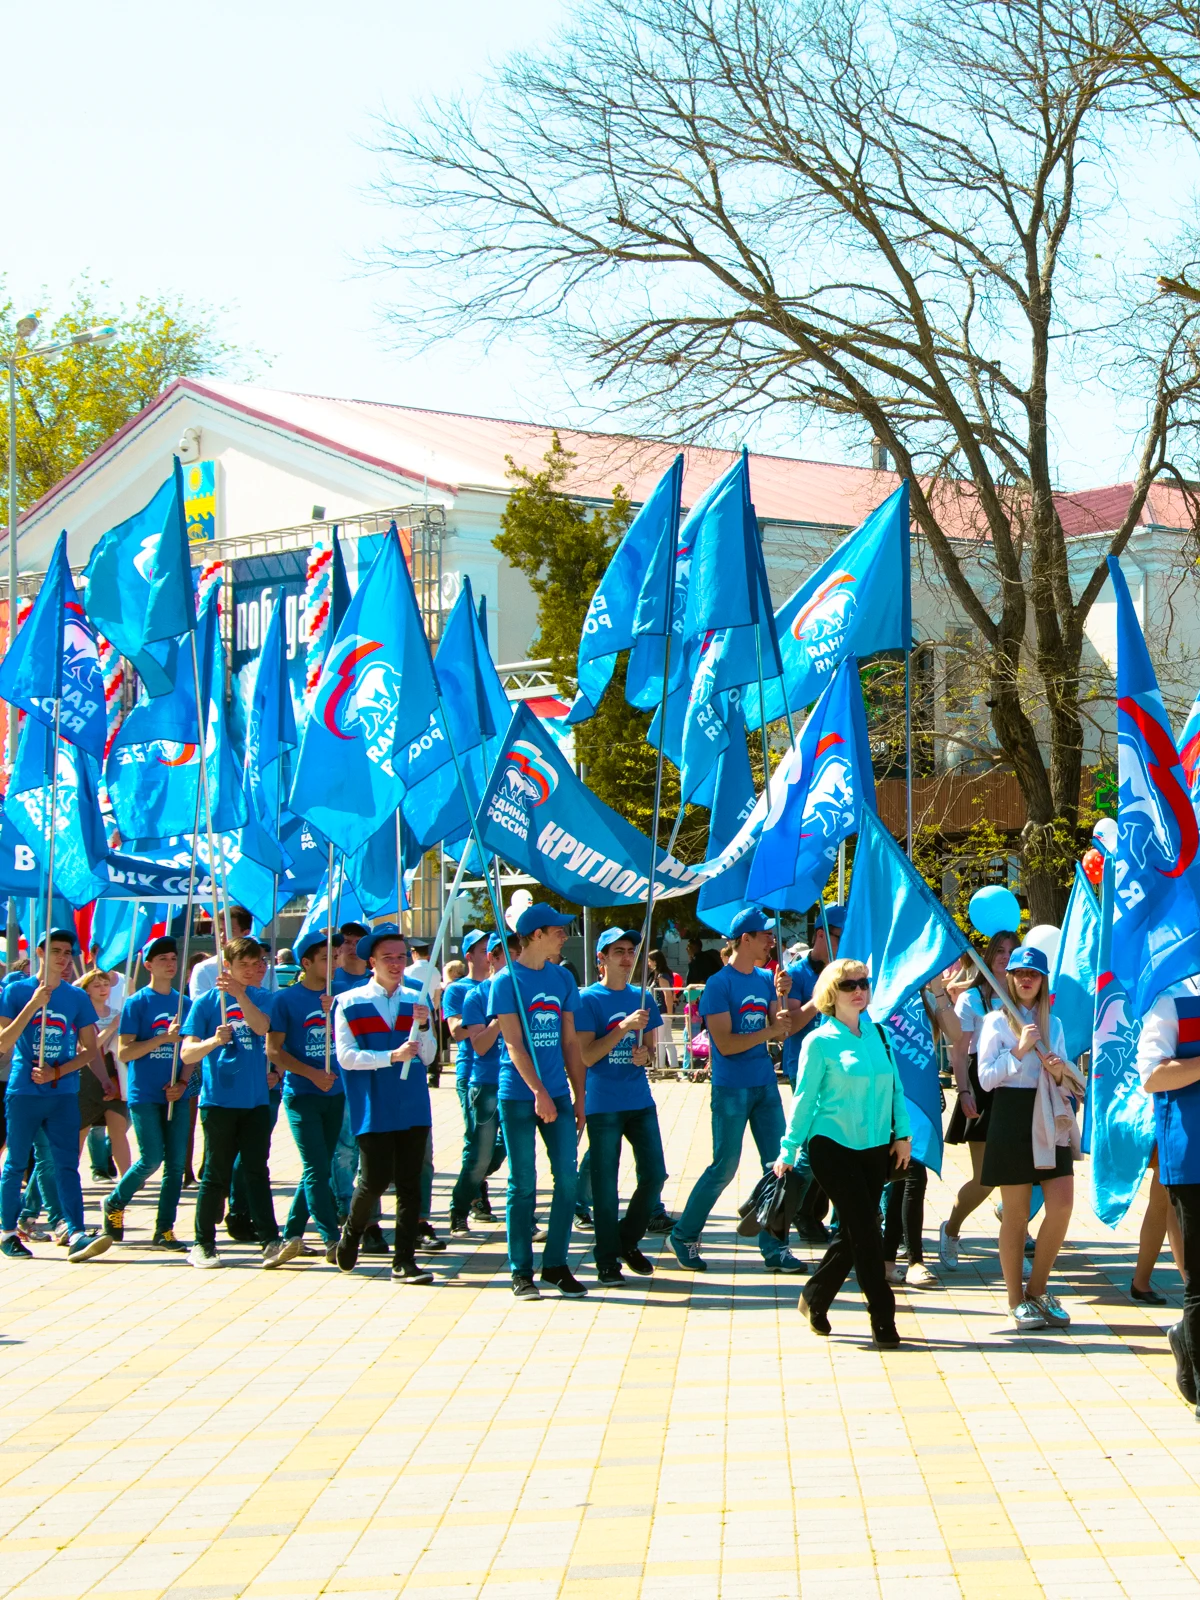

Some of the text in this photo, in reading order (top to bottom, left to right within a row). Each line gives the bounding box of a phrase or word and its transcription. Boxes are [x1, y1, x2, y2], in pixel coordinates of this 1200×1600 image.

[236, 587, 310, 660] побда
[487, 806, 528, 841] РОССИЯ
[491, 794, 530, 828] ЕДИНАЯ
[533, 1039, 558, 1047] ОССИЯ
[886, 1026, 929, 1070] СИЯ
[890, 1010, 935, 1056] ИНАЯ
